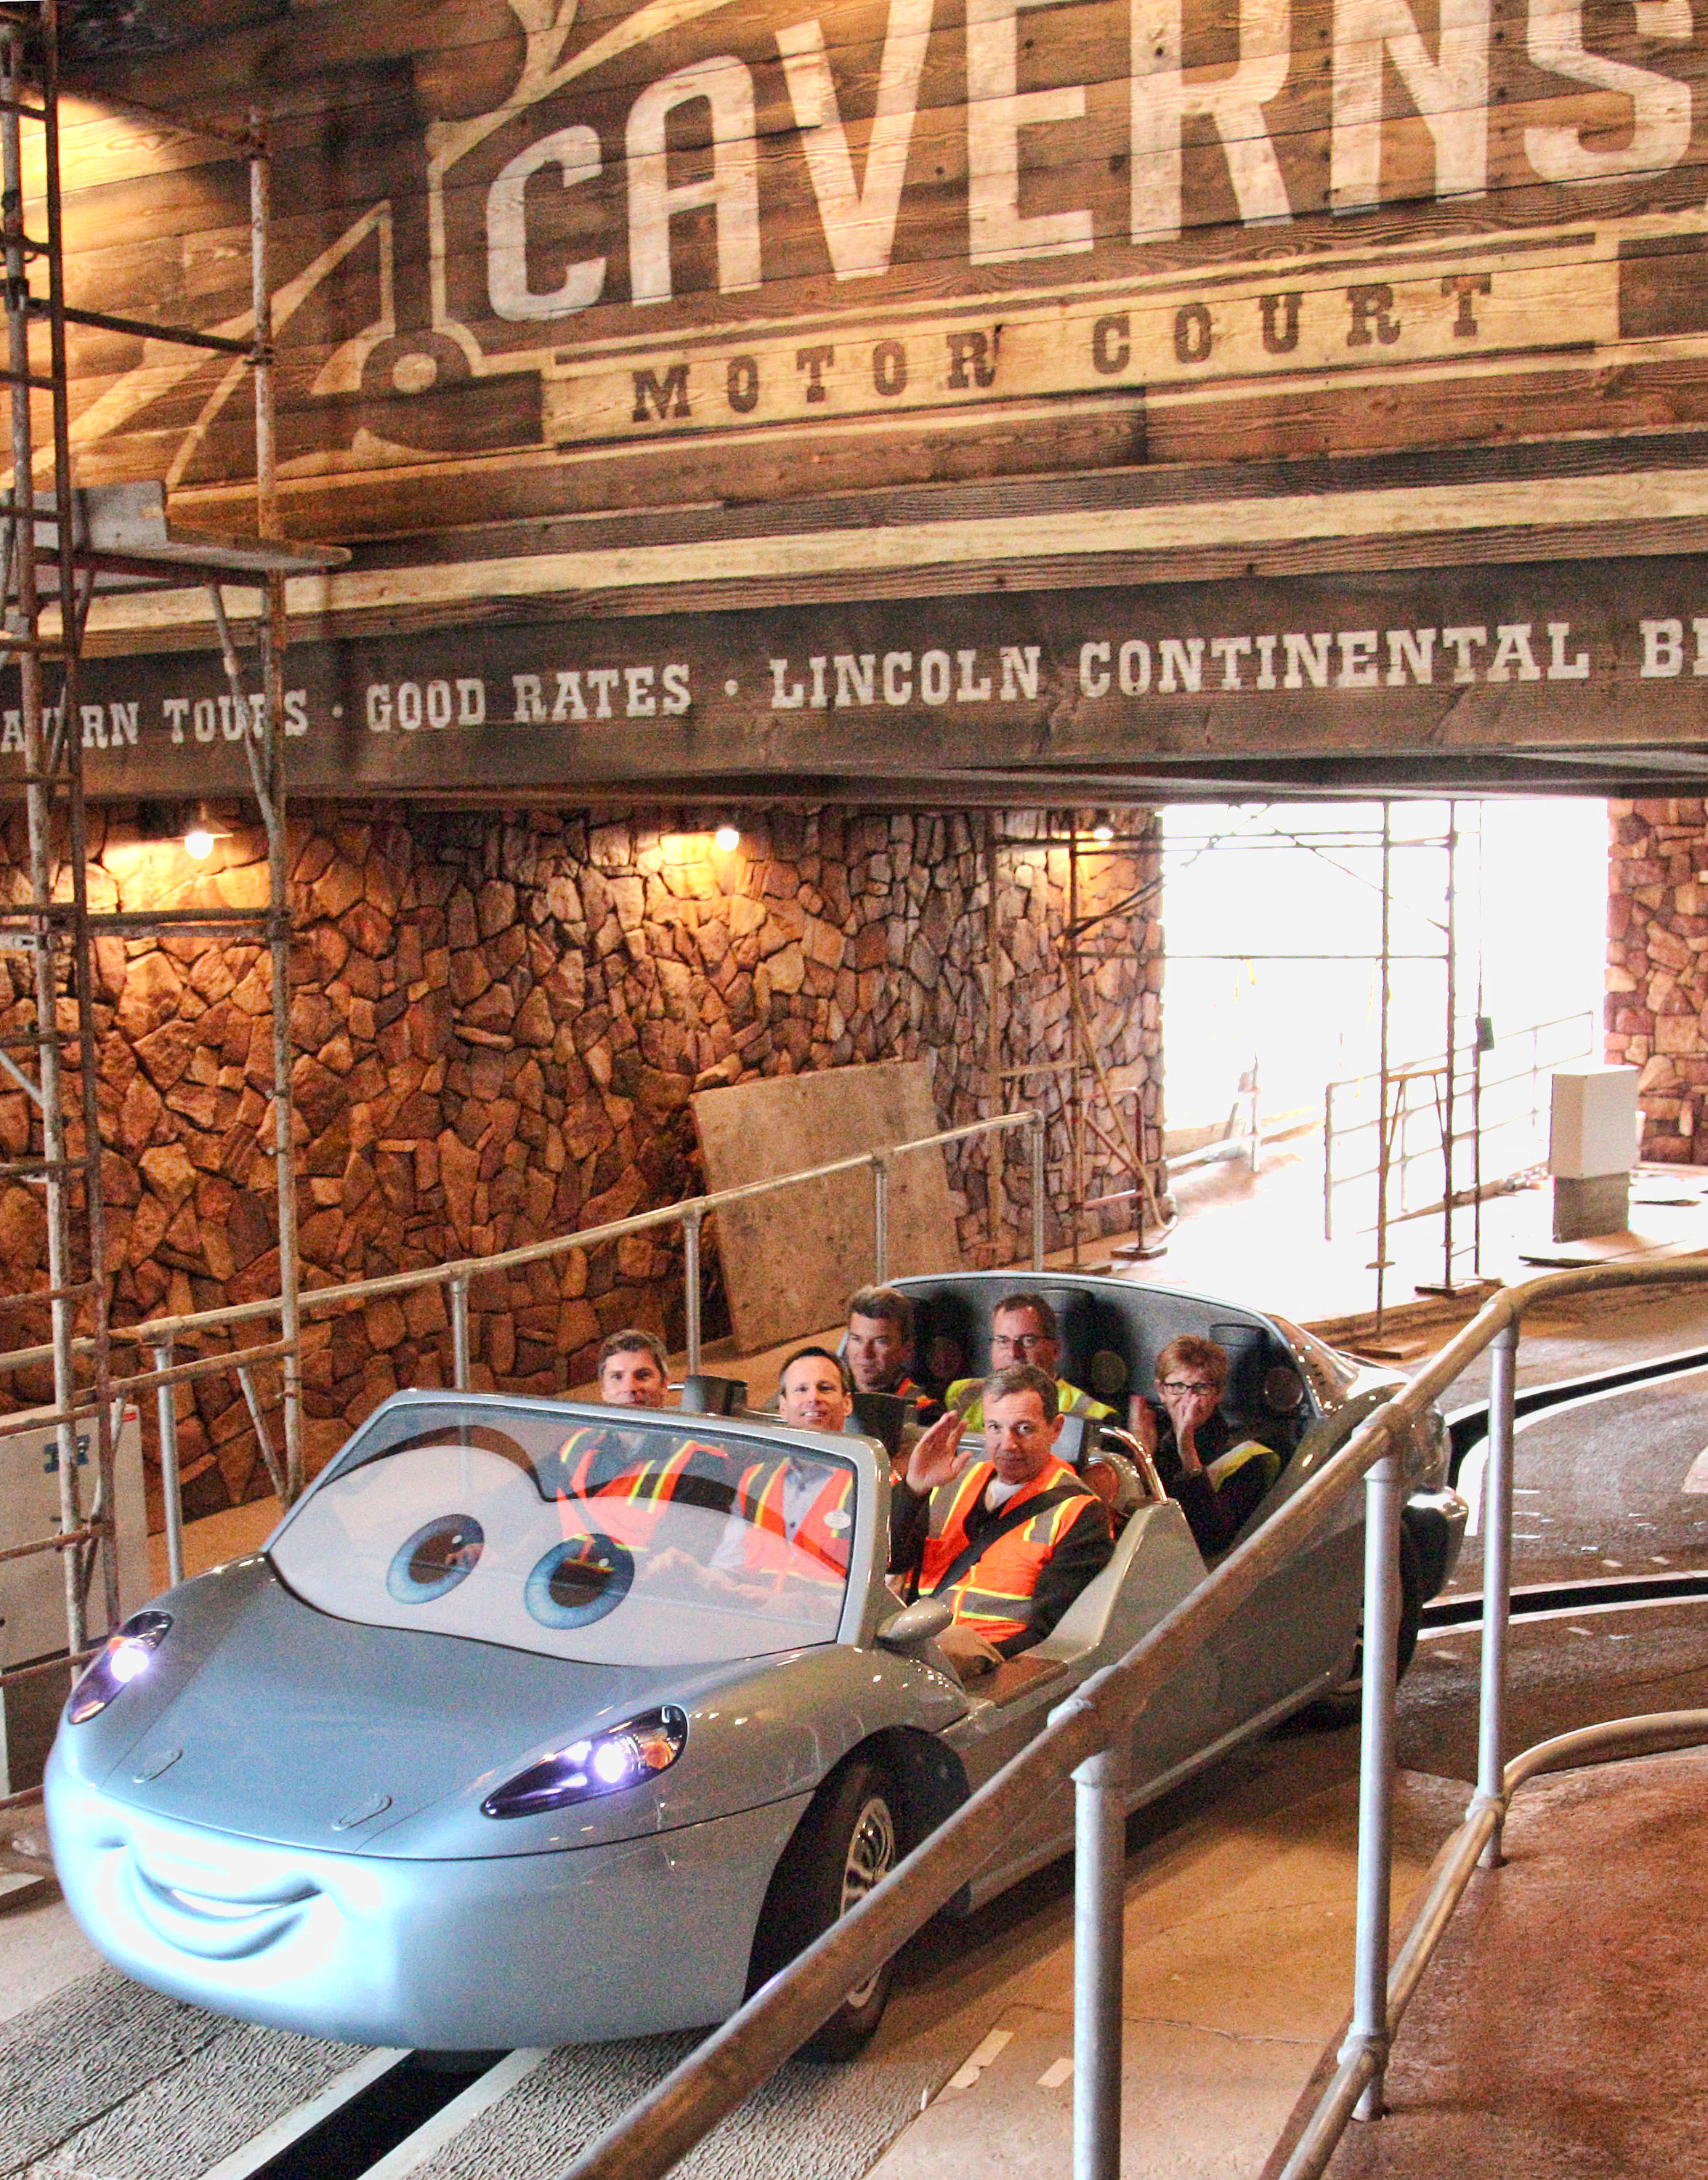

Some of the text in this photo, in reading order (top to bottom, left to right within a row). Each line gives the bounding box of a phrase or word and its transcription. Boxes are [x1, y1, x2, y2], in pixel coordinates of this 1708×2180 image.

[487, 0, 1693, 322] CAVERNS
[631, 272, 1492, 423] MOTOR COURT
[366, 678, 487, 732] GOOD
[511, 663, 692, 724] RATES
[769, 645, 1042, 711] LINCOLN
[1078, 621, 1590, 698] CONTINENTAL
